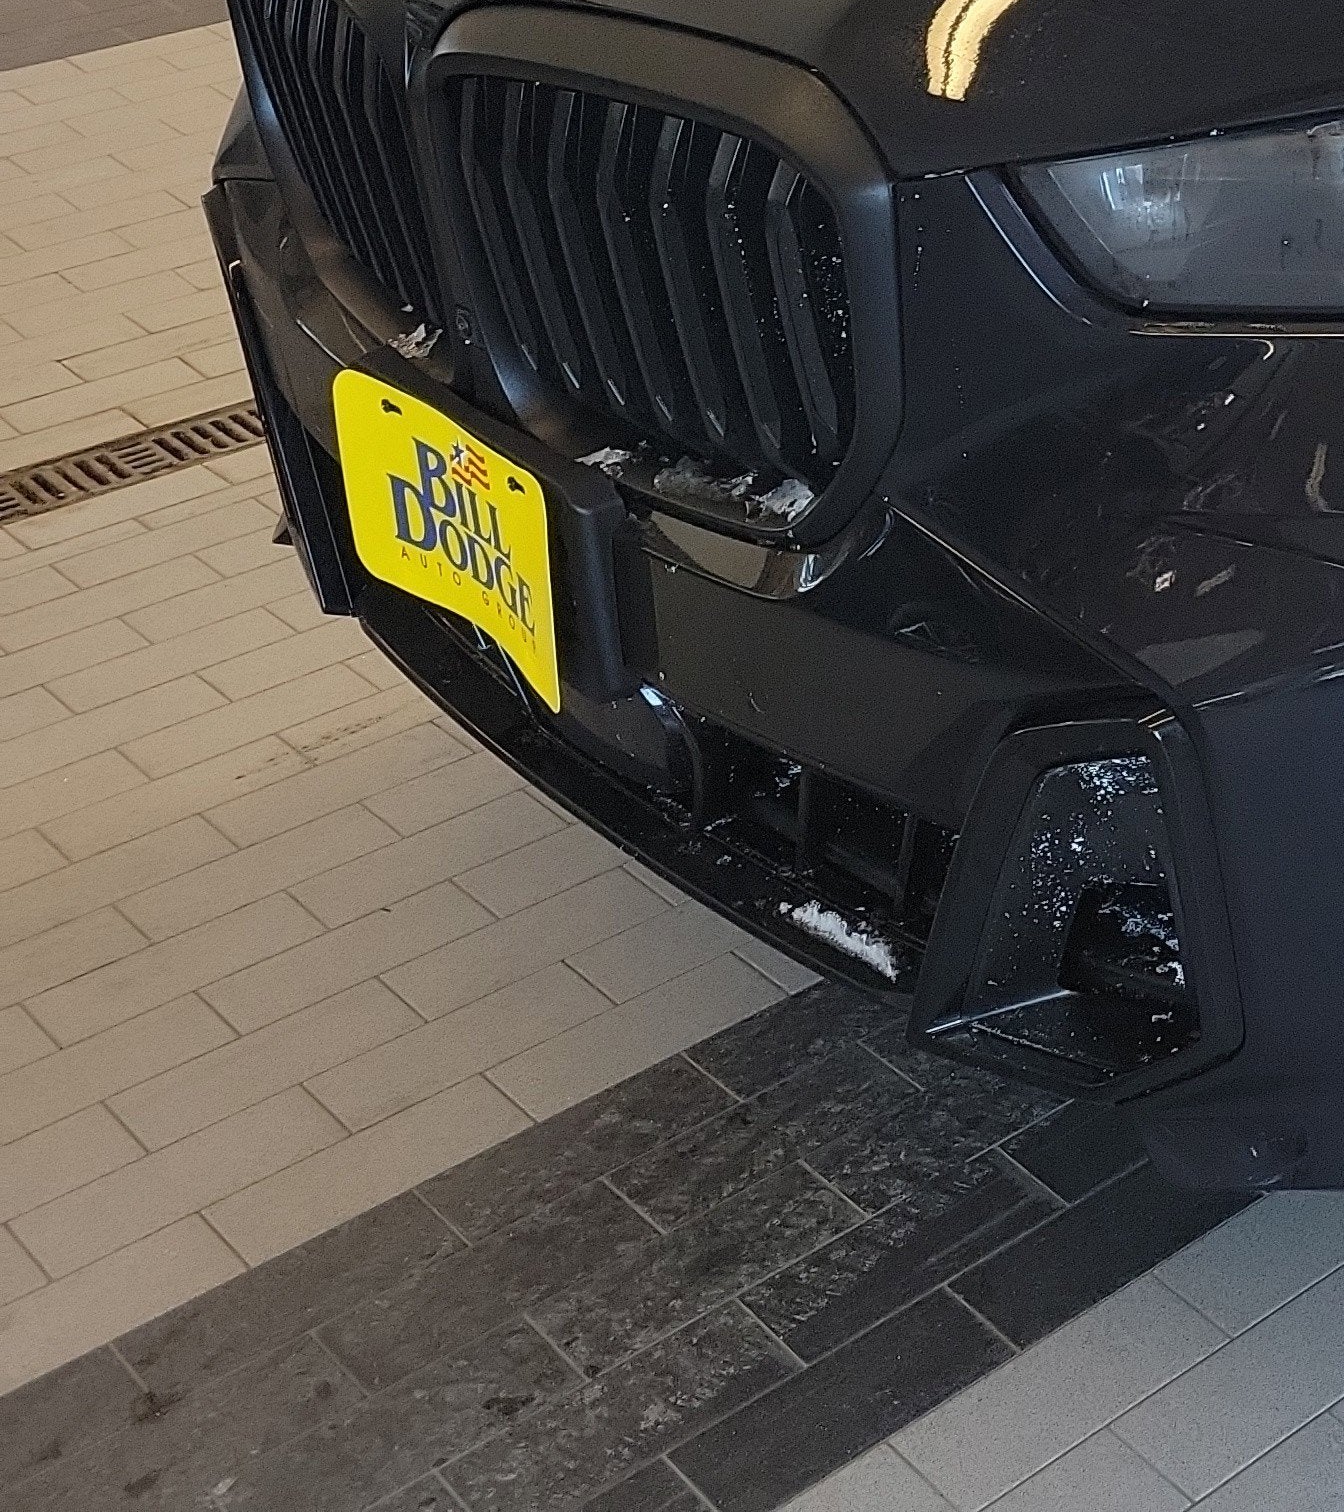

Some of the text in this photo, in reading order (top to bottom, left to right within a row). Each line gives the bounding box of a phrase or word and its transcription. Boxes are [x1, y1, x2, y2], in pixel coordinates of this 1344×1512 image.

[385, 472, 536, 634] DODGE
[412, 437, 511, 560] BILL
[401, 546, 462, 587] AUTO
